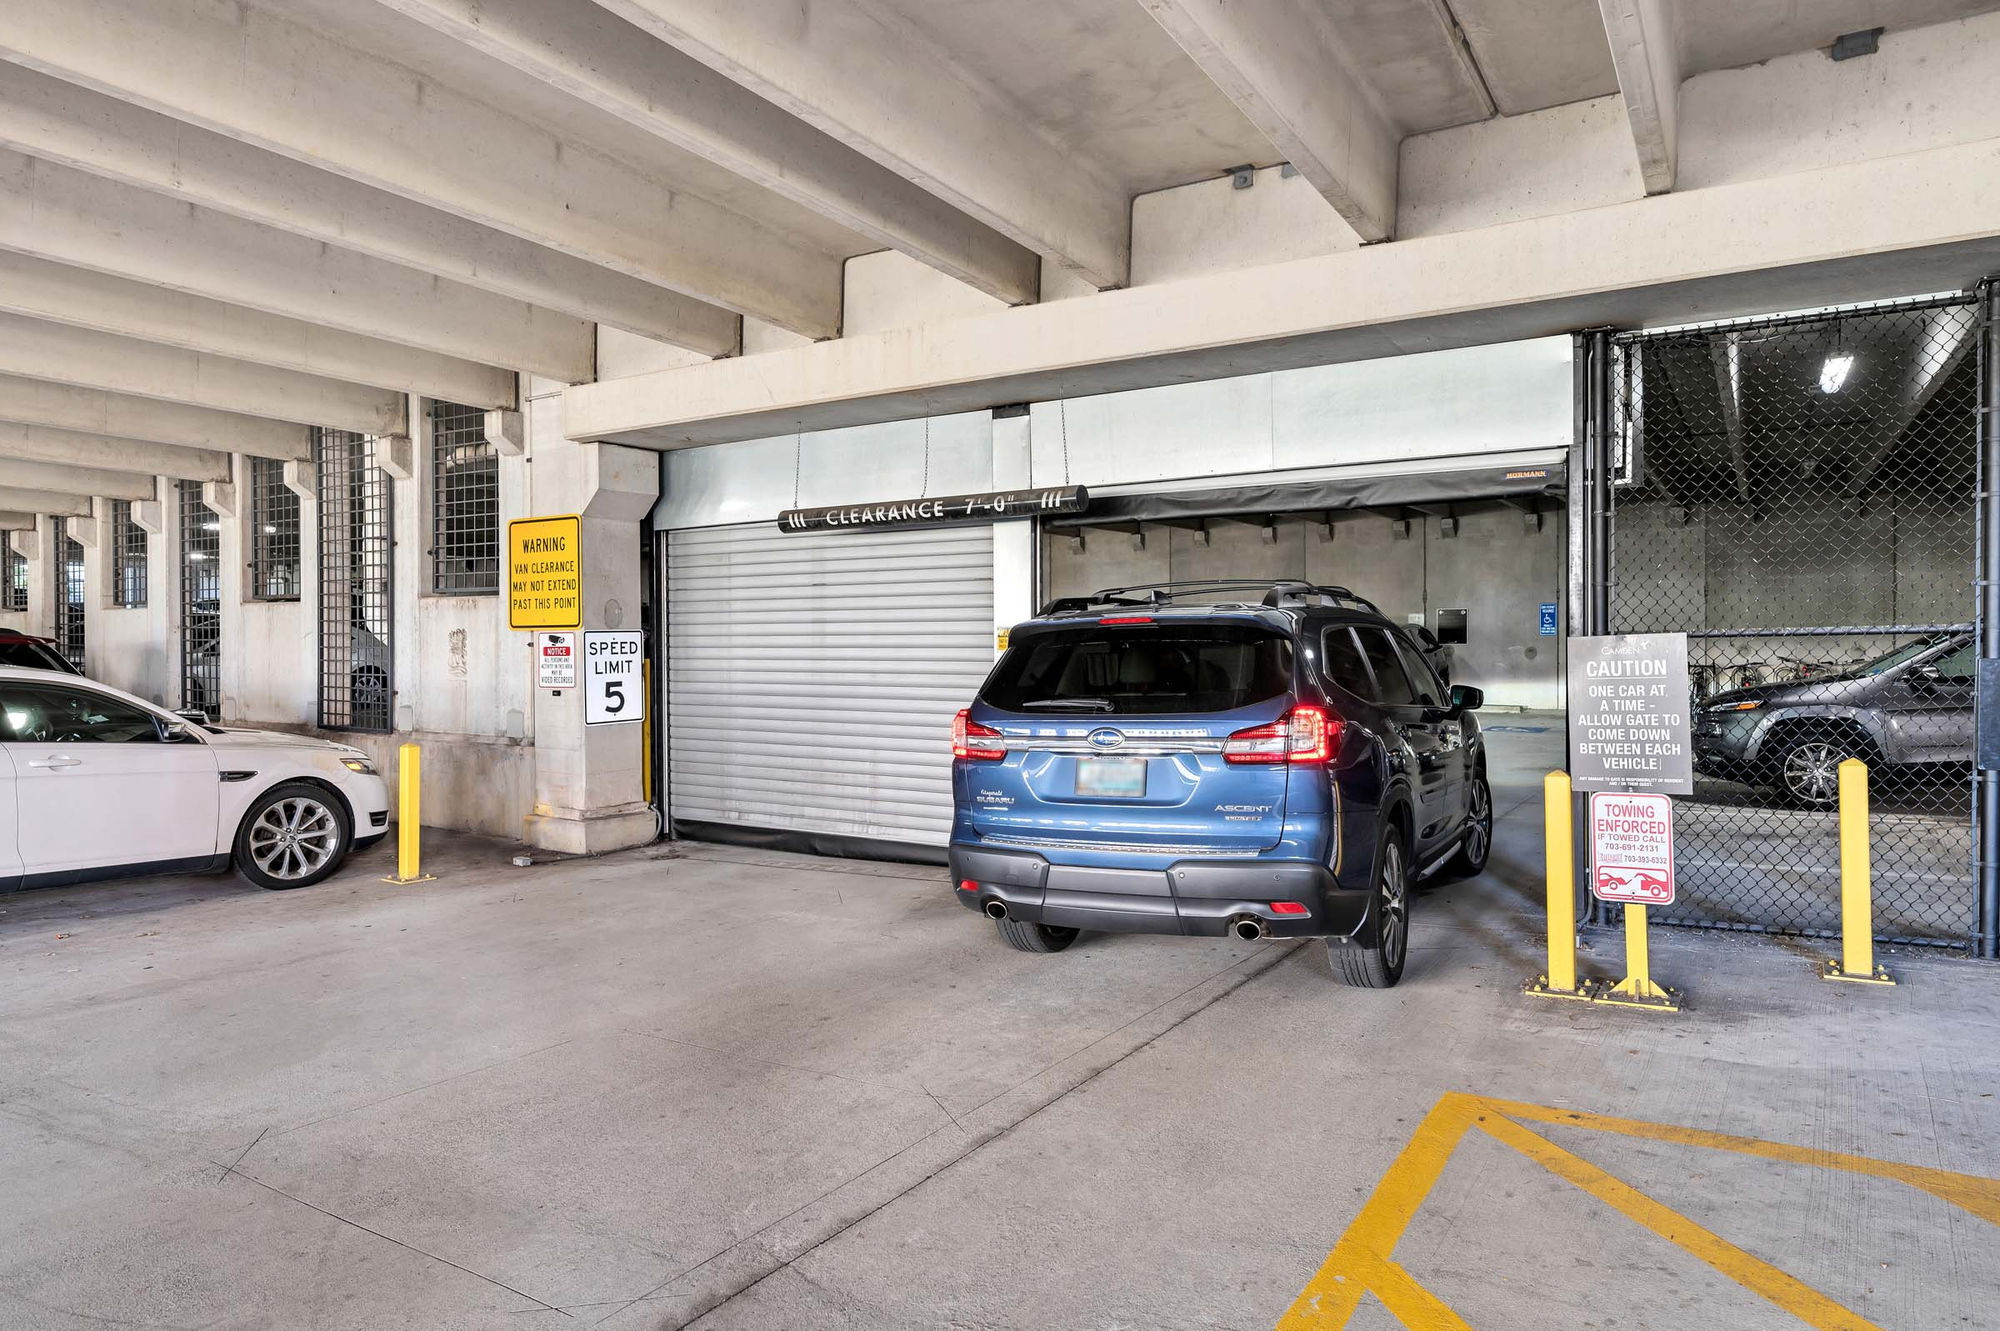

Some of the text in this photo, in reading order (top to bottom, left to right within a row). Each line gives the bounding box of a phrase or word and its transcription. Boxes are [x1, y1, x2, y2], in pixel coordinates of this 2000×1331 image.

[826, 494, 1014, 526] CLEARANCE 7'-0"
[522, 536, 566, 554] WARNING
[514, 560, 574, 574] VAN CLEARANCE
[512, 579, 576, 592] MAY NOT EXTEND
[513, 597, 576, 610] PAST THIS POINT
[546, 648, 567, 656] NOTICE
[589, 642, 638, 656] SPEED
[595, 660, 633, 674] LIMIT
[1586, 660, 1667, 676] CAUTION
[605, 681, 625, 713] 5
[1588, 685, 1615, 697] ONE
[1618, 685, 1645, 697] CAR
[1600, 700, 1609, 711] A
[1613, 699, 1645, 711] TIME
[1578, 714, 1680, 726] ALLOW GATE TO
[1588, 729, 1670, 741] COME DOWN
[1580, 743, 1681, 755] BETWEEN EACH
[1603, 757, 1657, 770] VEHICLE
[976, 796, 1015, 804] SUBARU
[1605, 804, 1655, 818] TOWING
[1598, 819, 1666, 834] ENFORCED
[1608, 834, 1640, 842] TOWED
[1642, 835, 1666, 843] CALL
[1605, 843, 1659, 852] 703-691-2131
